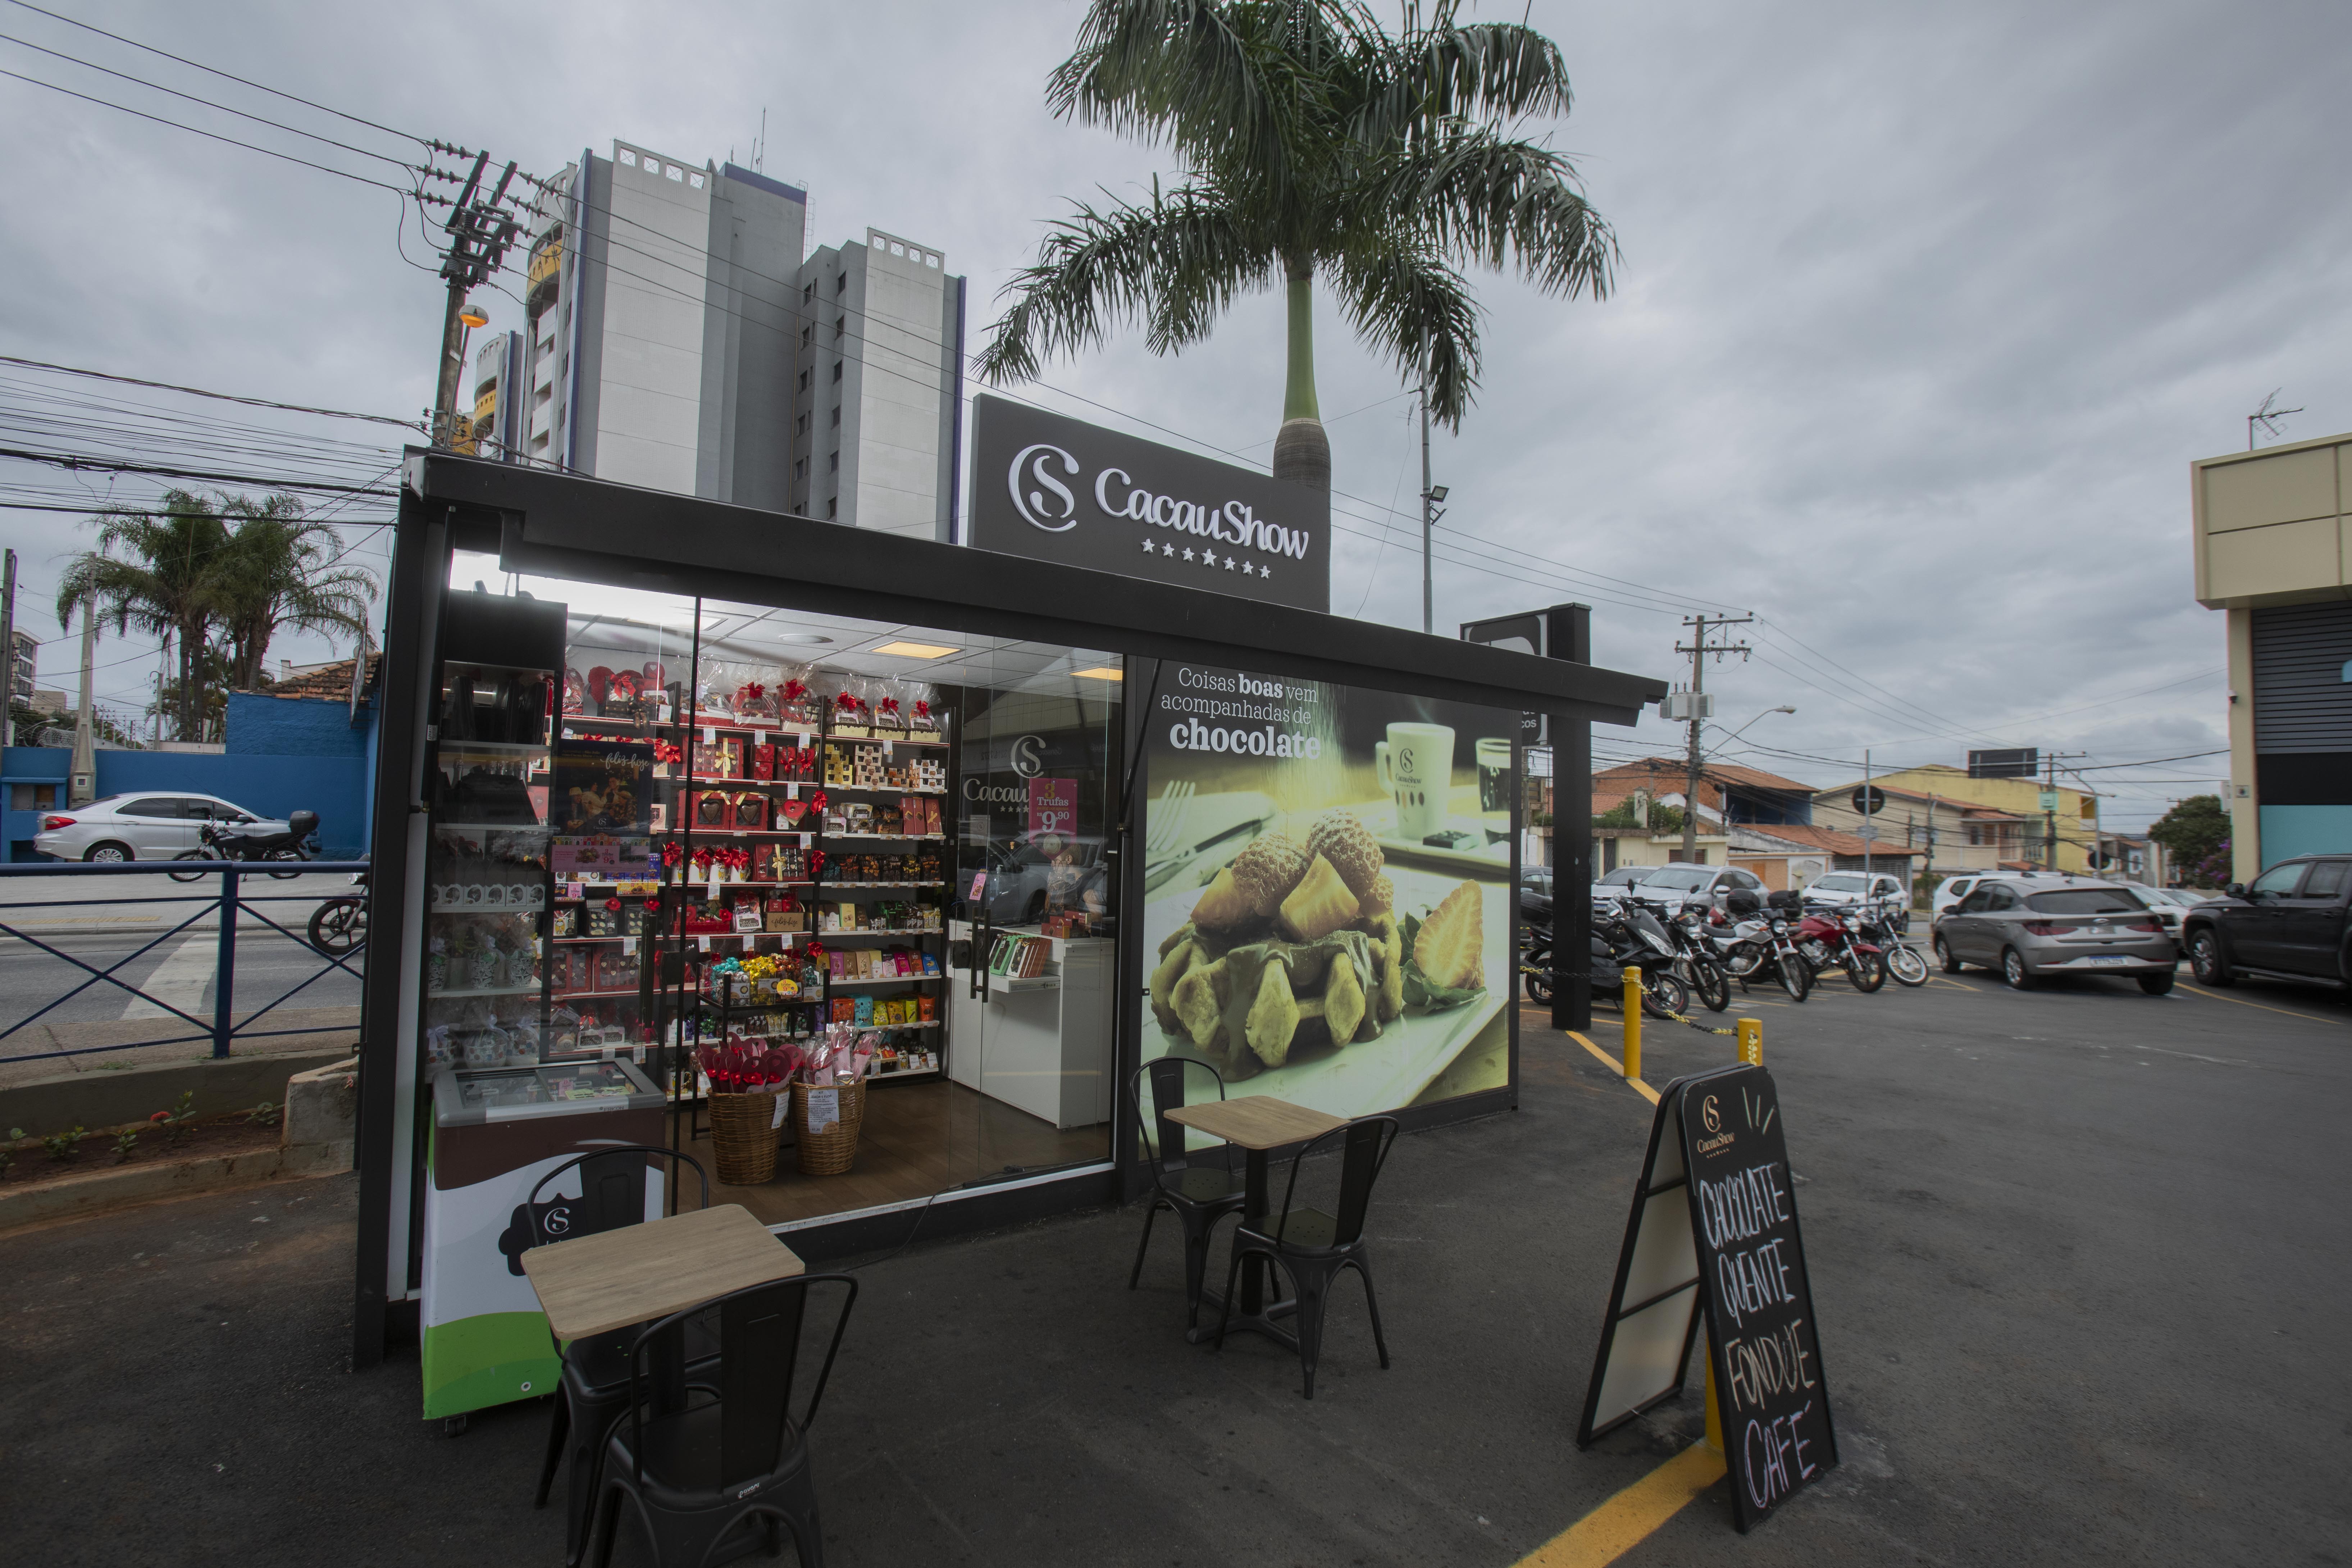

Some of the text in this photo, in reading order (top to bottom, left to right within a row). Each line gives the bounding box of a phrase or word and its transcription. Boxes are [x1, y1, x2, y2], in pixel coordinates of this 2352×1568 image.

[1179, 668, 1318, 702] Coisas boas vem
[1161, 695, 1311, 724] acompanhadas de
[1170, 718, 1321, 760] chocolate
[963, 778, 1030, 802] Cacau
[1037, 797, 1069, 806] Trufas
[1044, 783, 1055, 799] 3
[1700, 1162, 1790, 1250] CHOCOLATE
[1717, 1238, 1796, 1329] QUENTE
[1726, 1318, 1816, 1412] FONDUE
[1744, 1400, 1816, 1509] CAFÉ
